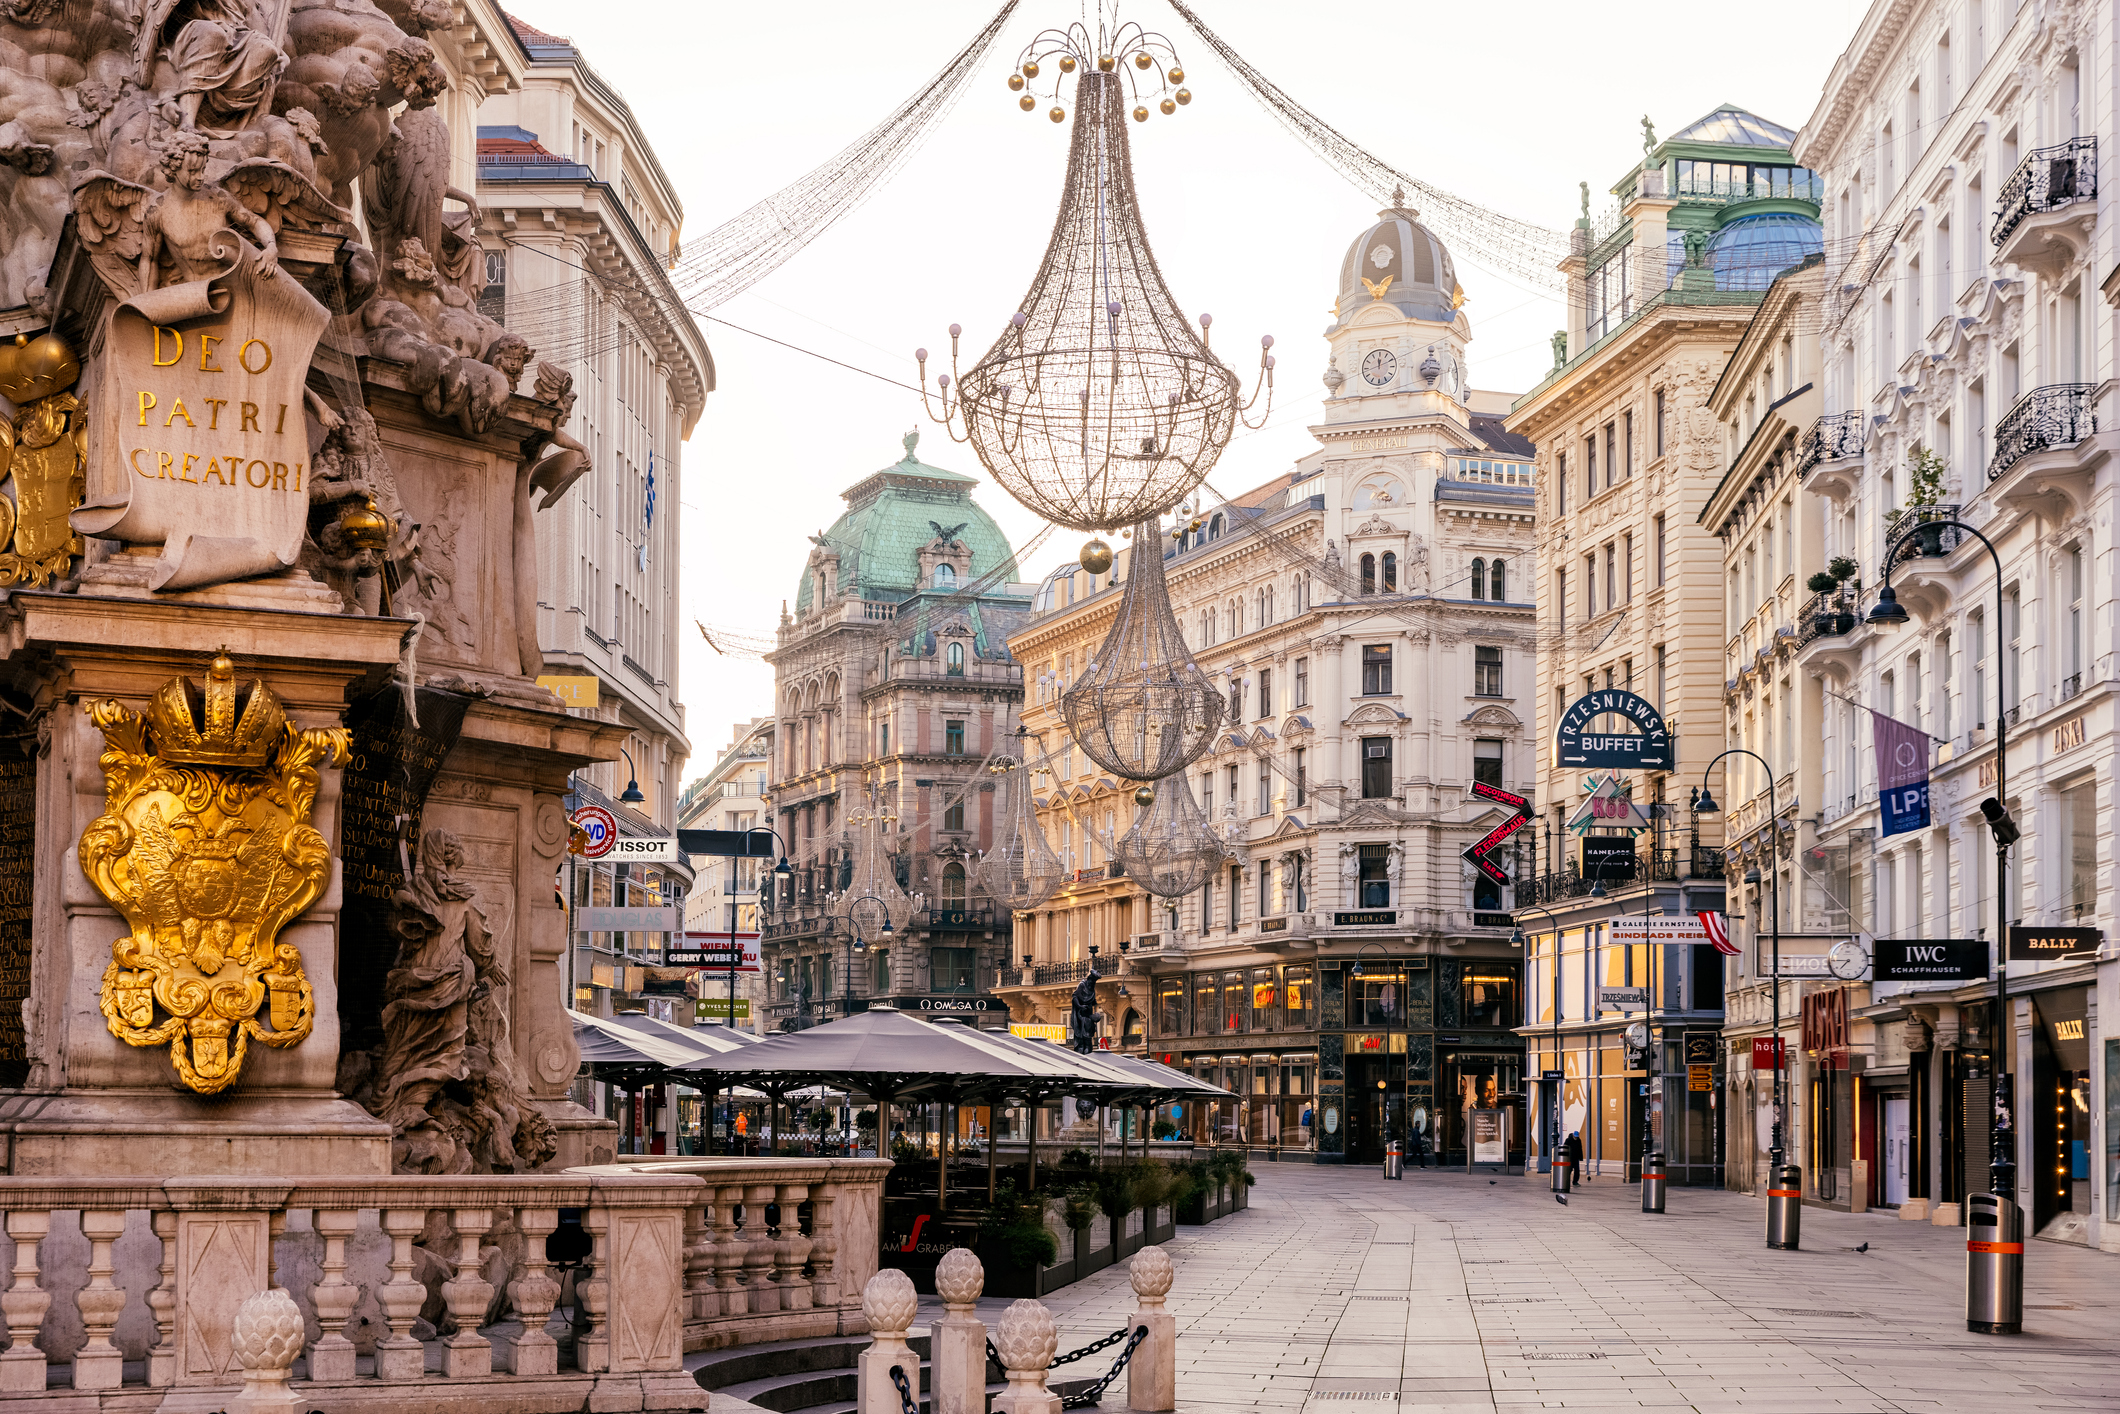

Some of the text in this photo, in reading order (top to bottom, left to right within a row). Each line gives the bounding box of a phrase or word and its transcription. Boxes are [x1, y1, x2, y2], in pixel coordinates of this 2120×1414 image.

[152, 325, 272, 374] DEO
[136, 391, 288, 434] PATRI
[1351, 436, 1408, 452] GENERALI
[130, 448, 303, 492] CREATORI
[1562, 694, 1664, 747] TRZEŚNIEWSKI
[2053, 716, 2086, 754] LISKA
[1582, 737, 1644, 752] BUFFET
[1476, 783, 1524, 804] DISCOTHEQUE
[1474, 815, 1526, 858] FLEDERMAUS
[612, 842, 667, 852] TISSOT
[1482, 860, 1496, 874] BAR
[592, 912, 662, 926] DOUGLAS
[2028, 939, 2077, 949] BALLY
[669, 954, 702, 962] GERRY
[703, 954, 739, 962] WEBER
[1905, 946, 1946, 963] IWC
[818, 1005, 830, 1014] OMGA
[934, 1002, 972, 1010] OMGA
[1801, 986, 1848, 1051] LISKA
[1014, 1026, 1063, 1039] STURMAYR
[2054, 1020, 2084, 1040] BALLY
[1364, 1038, 1380, 1049] H&M
[882, 1243, 900, 1252] AM
[916, 1243, 960, 1253] GRABE
